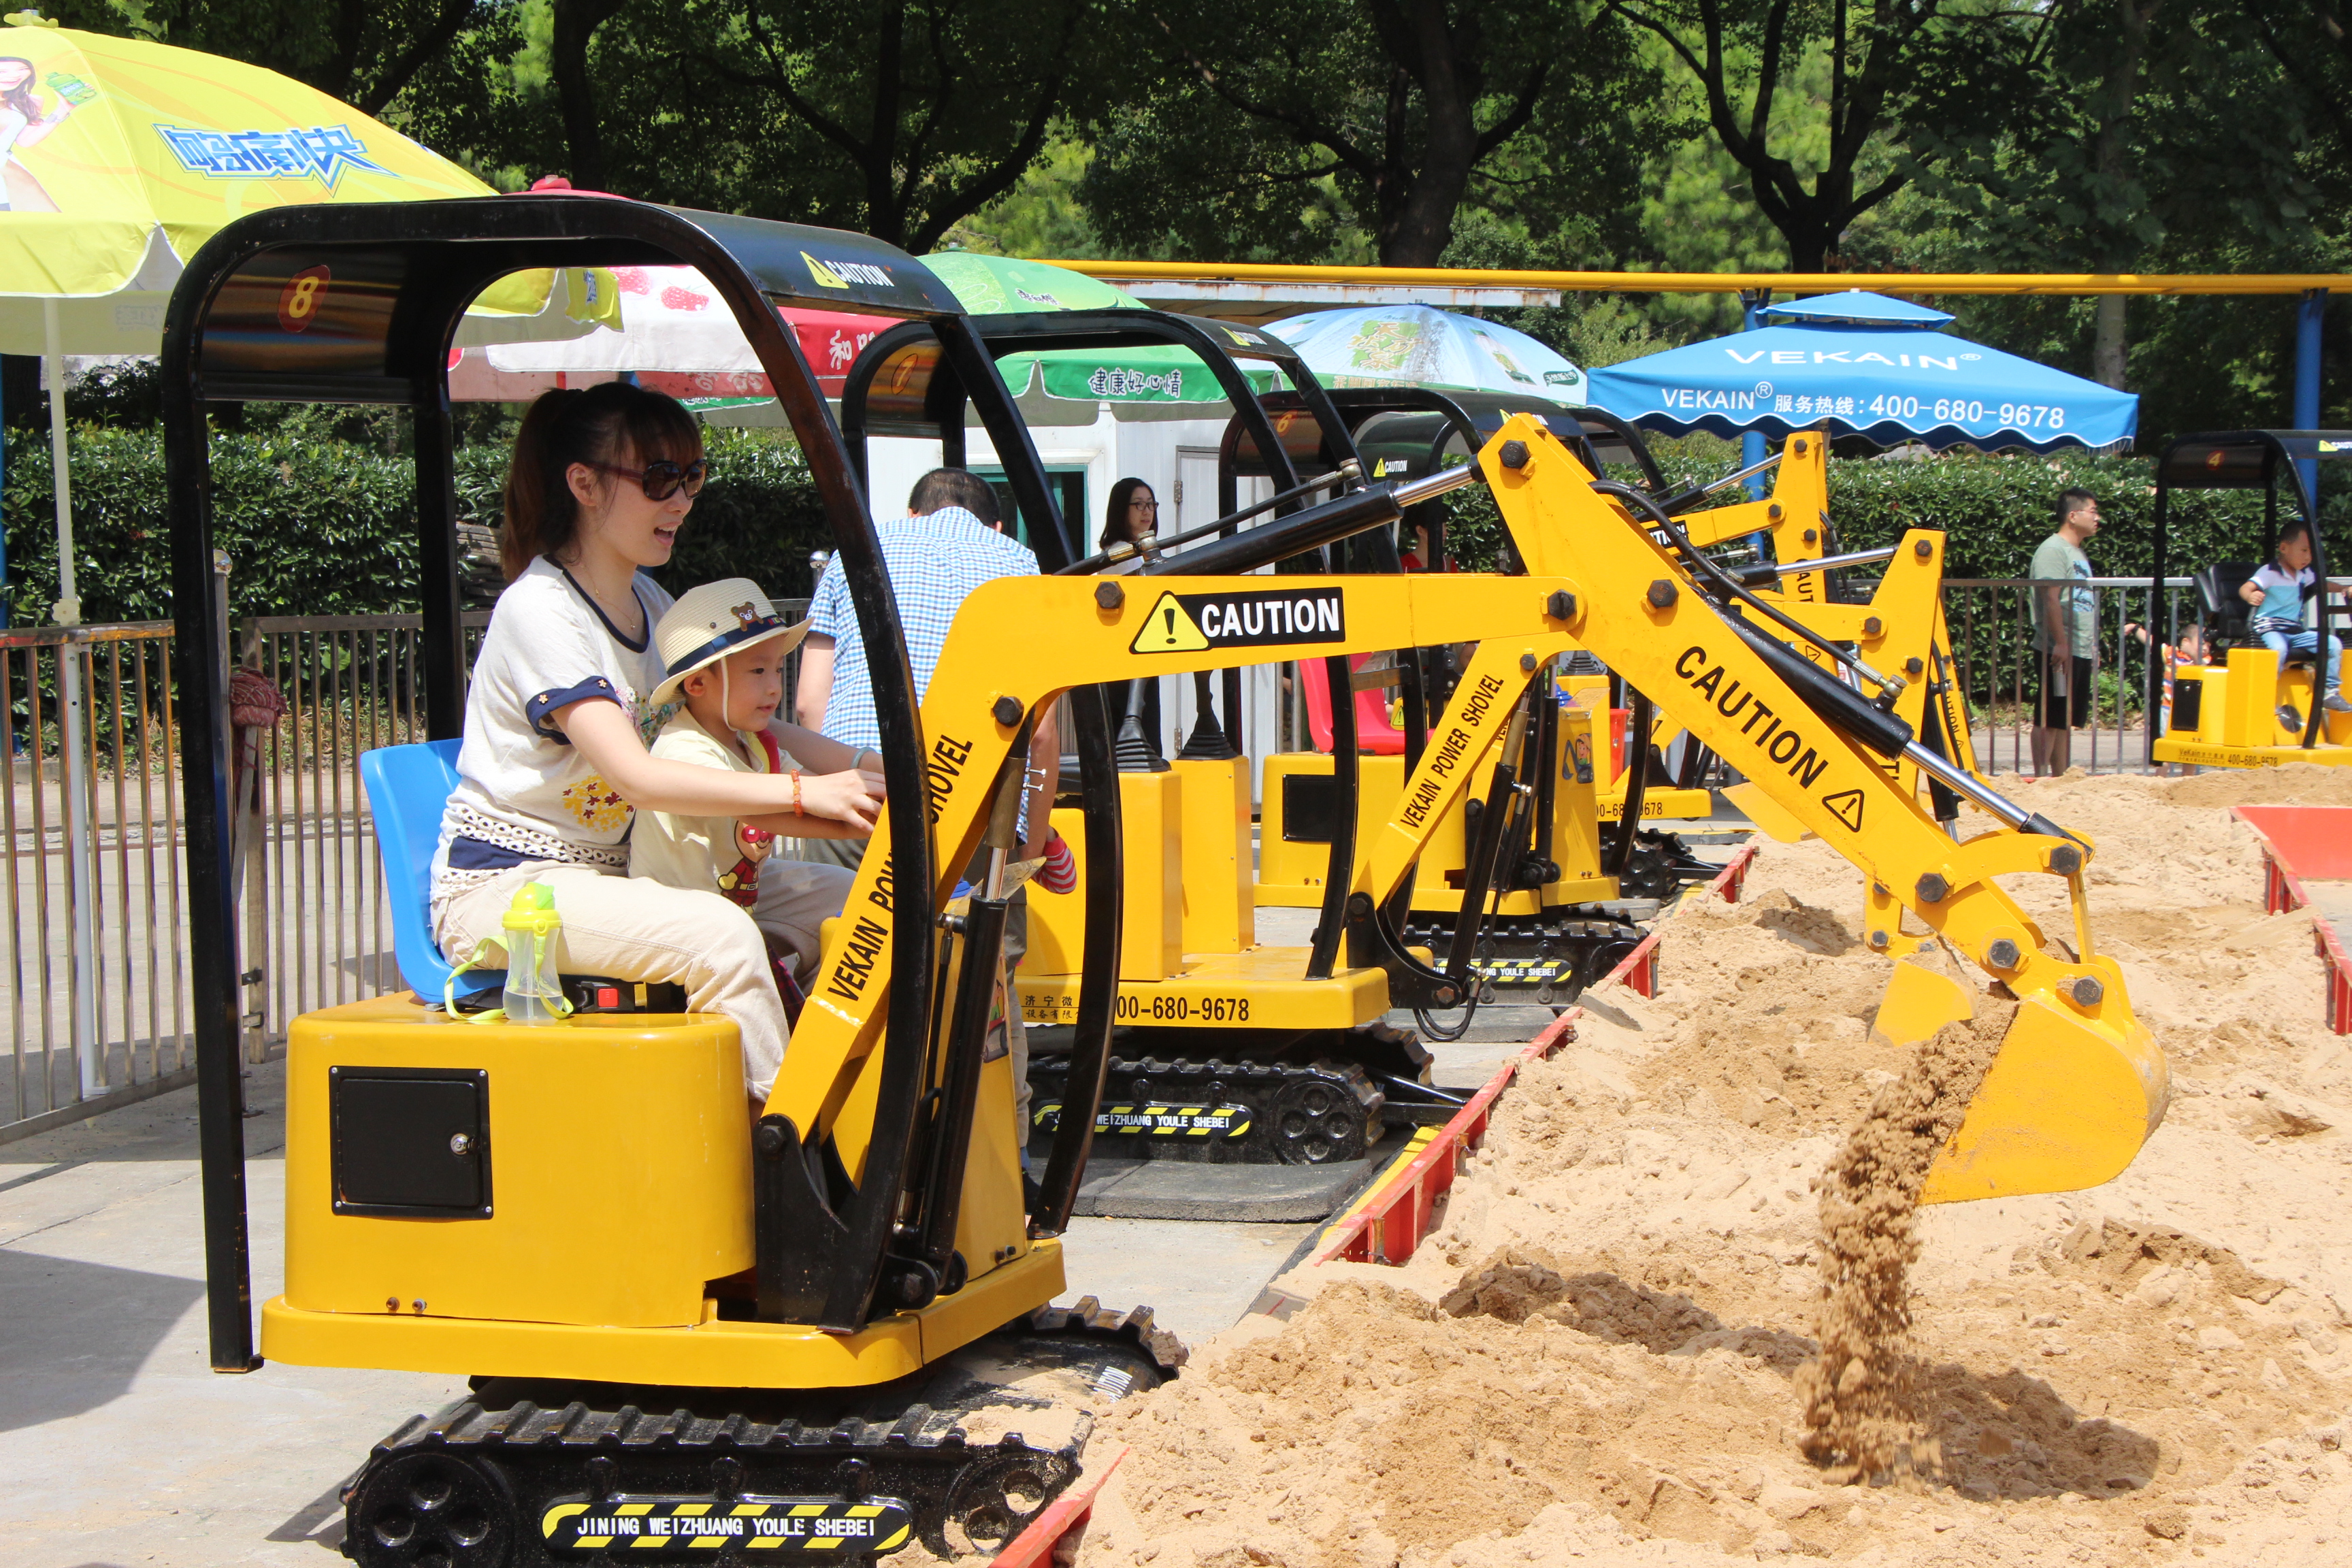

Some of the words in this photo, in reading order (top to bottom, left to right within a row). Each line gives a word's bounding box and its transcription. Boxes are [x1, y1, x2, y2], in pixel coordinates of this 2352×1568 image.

[825, 260, 896, 287] CAUTION
[288, 276, 319, 318] 8
[1725, 348, 1958, 370] VEKAIN
[896, 361, 915, 387] 7
[1088, 367, 1182, 398] 健康好心情
[1661, 388, 1754, 410] VEKAIN
[1868, 394, 2065, 429] 400-680-9678
[1277, 414, 1292, 433] 6
[1384, 459, 1407, 473] CAUTION
[2208, 453, 2221, 467] 4
[1201, 598, 1340, 638] CAUTION
[1675, 646, 1829, 790] CAUTION
[1400, 778, 1442, 829] VEKAIN
[1431, 728, 1471, 779] POWER
[1461, 674, 1505, 727] SHOVEL
[828, 915, 889, 1002] VEKAIN
[868, 848, 894, 914] POW
[1500, 967, 1524, 977] YOULE
[1528, 967, 1556, 977] SHEBEI
[1026, 1009, 1079, 1019] 设备有限
[1116, 995, 1250, 1022] 00-680-9678
[1096, 1114, 1152, 1126] WEIZHUANG
[1157, 1115, 1188, 1127] YOULE
[1193, 1116, 1230, 1128] SHEBEI
[577, 1517, 640, 1536] JINING
[649, 1517, 743, 1536] WEIZHUANG
[752, 1518, 805, 1536] YOULE
[815, 1518, 875, 1537] SHEBEI
